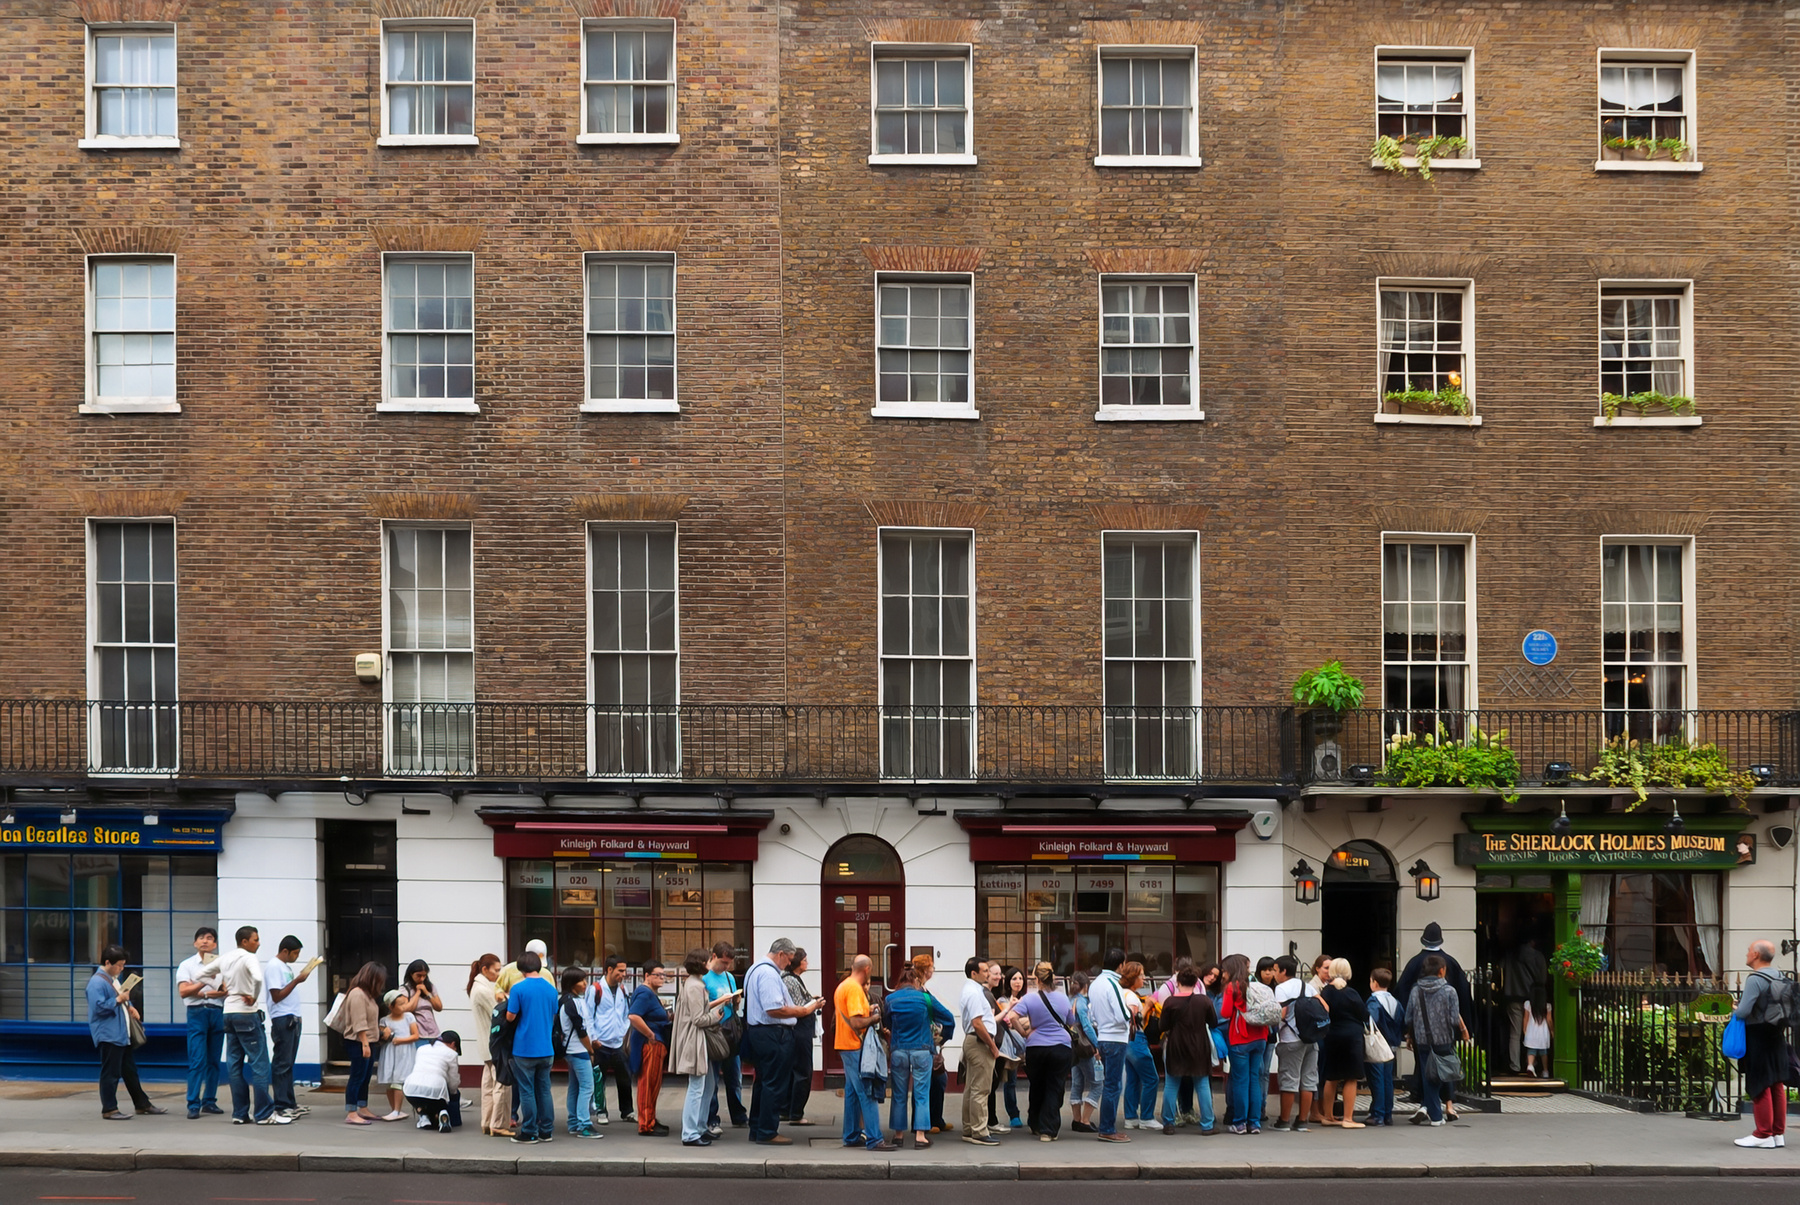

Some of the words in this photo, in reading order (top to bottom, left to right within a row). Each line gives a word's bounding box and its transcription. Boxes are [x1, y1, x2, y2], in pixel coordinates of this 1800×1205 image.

[0, 825, 22, 843] on
[26, 825, 88, 843] Beatles
[94, 826, 140, 844] Store
[560, 839, 597, 851] Kinleigh
[600, 839, 634, 849] Folkard
[637, 840, 645, 849] &
[648, 840, 690, 851] Hayward
[1039, 841, 1075, 853] Kinleigh
[1079, 841, 1113, 852] Folkard
[1116, 842, 1124, 852] &
[1127, 842, 1169, 854] Hayward
[1482, 833, 1507, 851] THE
[1510, 833, 1595, 851] SHERLOCK
[1600, 833, 1666, 851] HOLMES
[1670, 834, 1725, 852] MUSEUM
[1548, 851, 1581, 862] BOOKS
[1588, 850, 1643, 862] ANTIQUES
[1669, 849, 1704, 861] CURIOS
[519, 875, 544, 884] Sales
[569, 876, 588, 885] 020
[616, 876, 641, 885] 7486
[665, 877, 689, 886] 5551
[980, 879, 1022, 890] Lettings
[1042, 880, 1060, 889] 020
[1089, 879, 1114, 889] 7499
[1139, 880, 1162, 889] 6181
[855, 912, 870, 921] 237
